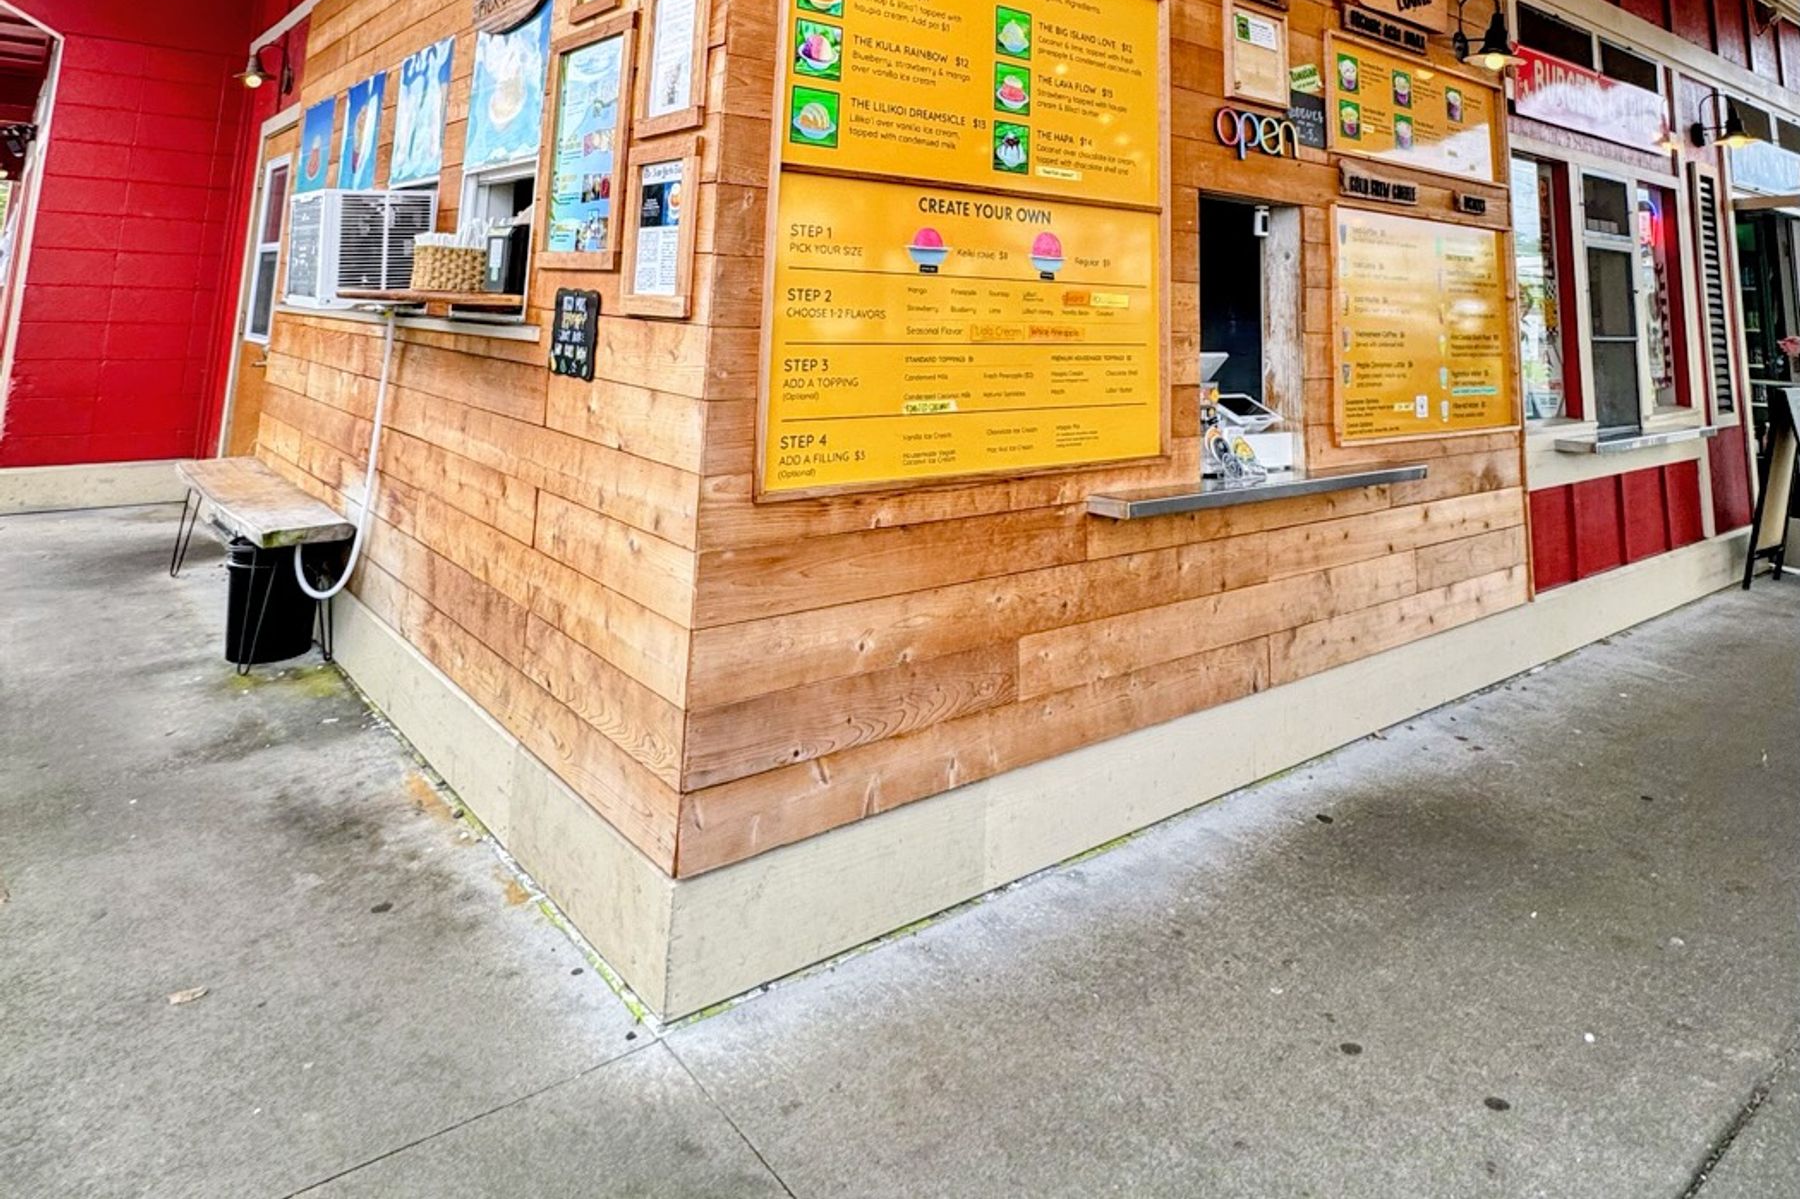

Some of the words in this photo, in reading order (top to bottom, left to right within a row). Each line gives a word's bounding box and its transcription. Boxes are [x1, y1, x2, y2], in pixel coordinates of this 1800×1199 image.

[911, 14, 927, 27] Add
[919, 5, 945, 21] topped
[947, 12, 962, 23] with
[1038, 22, 1053, 34] THE
[1055, 26, 1069, 37] BIG
[852, 35, 874, 48] THE
[875, 38, 902, 54] KULA
[903, 44, 949, 63] RAINBOW
[955, 56, 970, 68] $12
[851, 64, 870, 74] over
[871, 67, 899, 81] vanilla
[899, 72, 911, 82] ice
[912, 76, 937, 87] cream
[945, 70, 972, 83] mango
[1037, 74, 1053, 86] THE
[1055, 77, 1074, 90] LAVA
[1075, 81, 1097, 95] FLOW
[1036, 100, 1057, 110] cream
[1037, 88, 1072, 103] Strawberry
[1072, 94, 1095, 108] topped
[1095, 100, 1108, 110] with
[850, 97, 871, 110] THE
[873, 101, 908, 116] LILIKOI
[908, 106, 966, 126] DREAMSICLE
[972, 117, 987, 129] $13
[876, 119, 894, 128] over
[895, 121, 922, 133] vanilla
[922, 125, 934, 134] ice
[1216, 106, 1300, 161] open
[848, 126, 880, 140] topped
[880, 131, 897, 141] with
[898, 135, 940, 148] condensed
[940, 139, 957, 150] milk
[1036, 130, 1052, 141] THE
[1053, 133, 1075, 145] HAPA
[1036, 144, 1062, 155] Coconut
[1062, 148, 1077, 157] over
[1036, 155, 1059, 168] topped
[1060, 158, 1073, 168] with
[918, 196, 970, 217] CREATE
[972, 202, 1012, 221] YOUR
[1016, 207, 1052, 225] OWN
[790, 223, 823, 238] STEP
[827, 227, 832, 239] 1
[789, 242, 812, 254] PICK
[814, 244, 840, 255] YOUR
[843, 246, 864, 256] SIZE
[787, 287, 822, 303] STEP
[824, 290, 832, 303] 2
[786, 307, 828, 319] CHOOSE
[830, 308, 843, 319] 1-2
[844, 309, 887, 321] FLAVORS
[906, 304, 939, 314] Strawberry
[905, 325, 940, 336] Seasonal
[940, 326, 964, 336] Flavor
[783, 358, 818, 373] STEP
[821, 359, 829, 372] 3
[783, 378, 805, 389] ADD
[807, 378, 815, 388] A
[817, 376, 859, 389] TOPPING
[904, 373, 936, 382] Condensed
[782, 391, 820, 402] (Optional)
[779, 435, 815, 450] STEP
[818, 433, 827, 447] 4
[778, 454, 801, 466] ADD
[802, 454, 810, 465] A
[812, 451, 850, 464] FILLING
[777, 468, 816, 480] (Optional)
